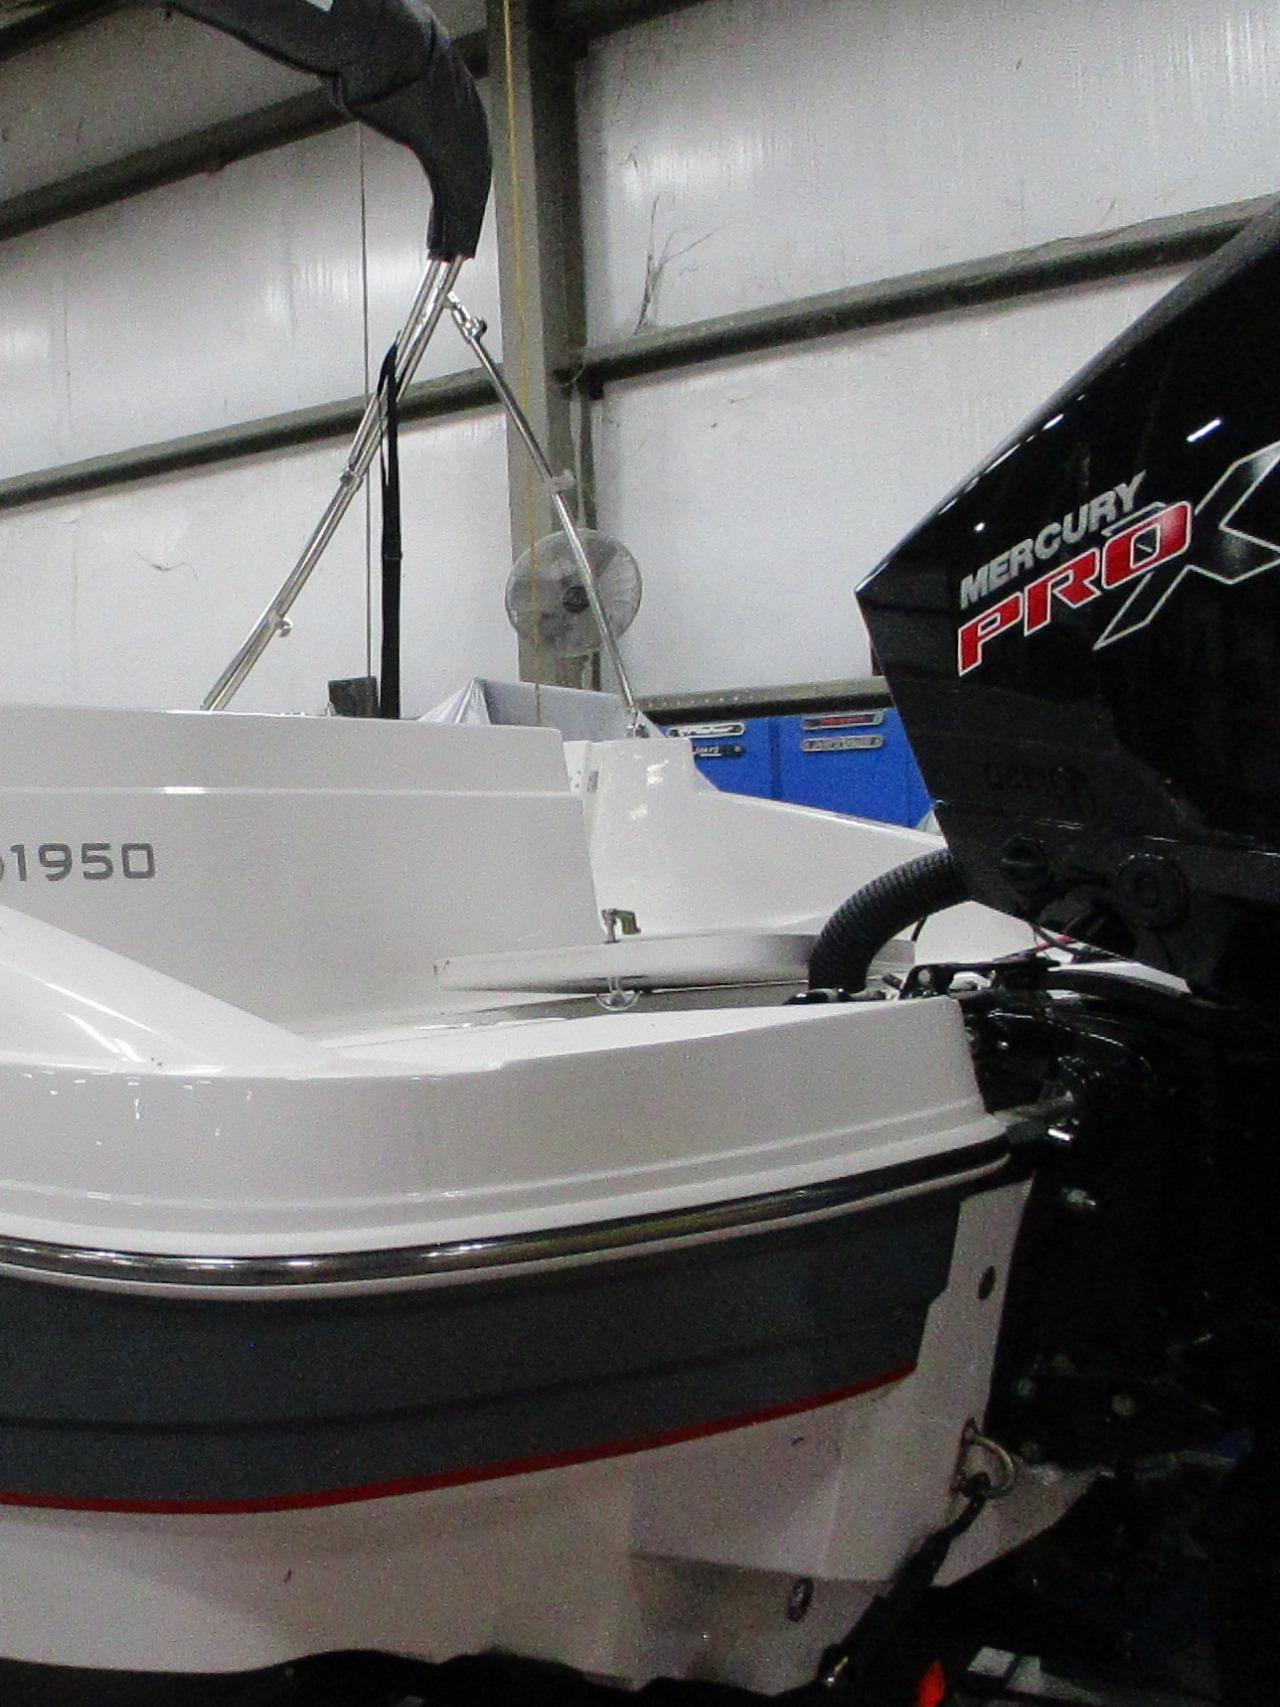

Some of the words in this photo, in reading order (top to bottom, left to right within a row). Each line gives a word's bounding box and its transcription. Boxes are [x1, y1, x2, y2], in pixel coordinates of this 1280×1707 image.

[957, 500, 1192, 677] PRO
[960, 470, 1147, 610] MERCURY
[10, 842, 156, 881] 1950
